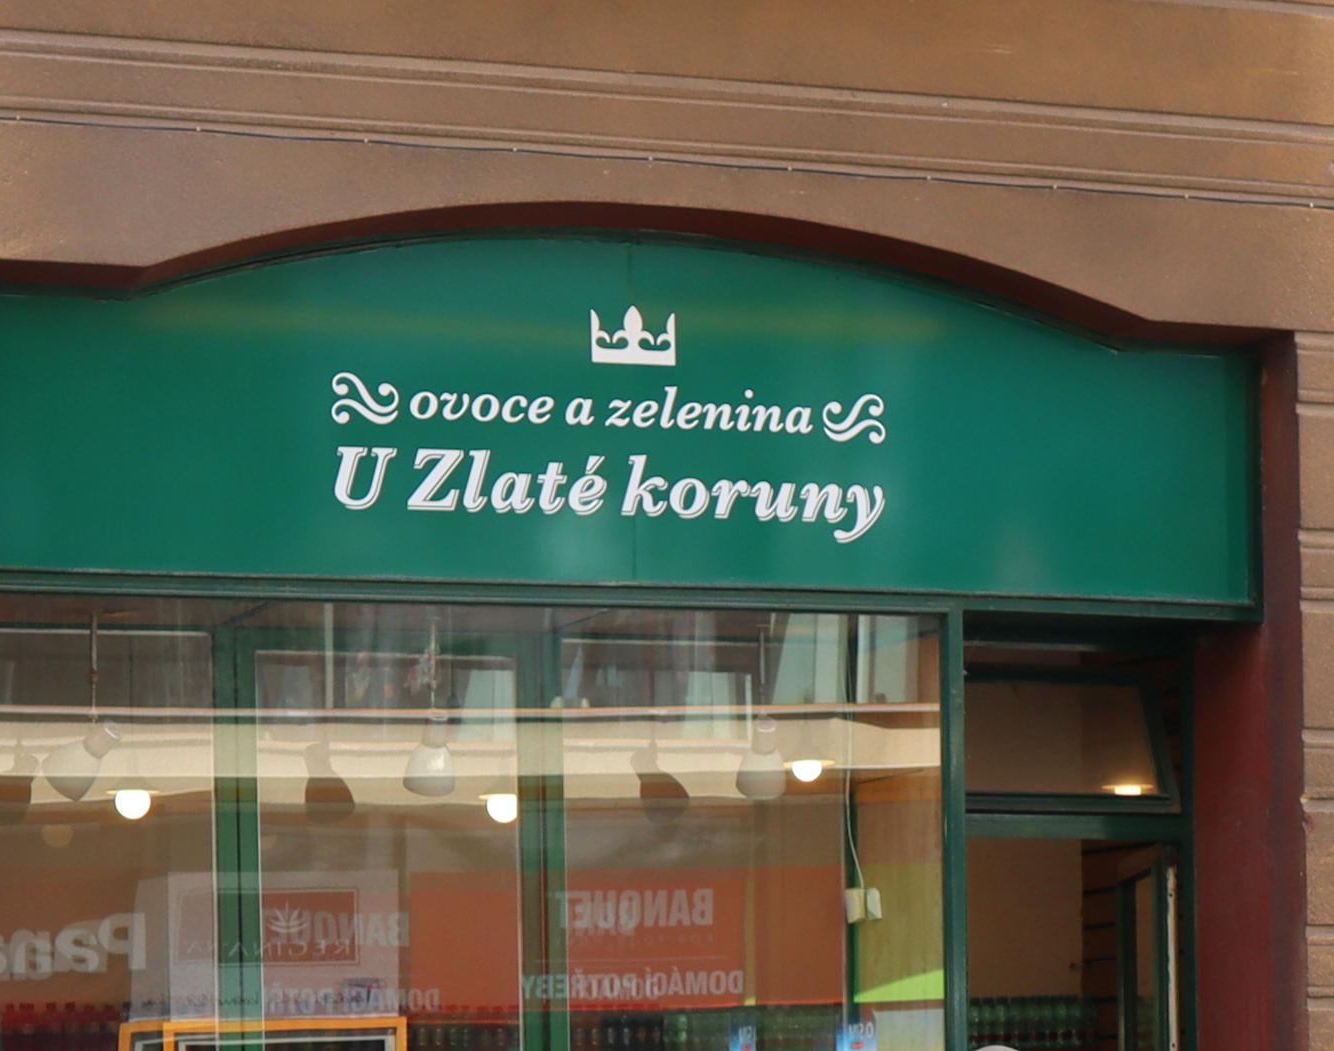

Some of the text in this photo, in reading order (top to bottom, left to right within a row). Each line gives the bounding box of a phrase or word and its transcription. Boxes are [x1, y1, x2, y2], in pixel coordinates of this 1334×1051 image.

[409, 385, 813, 433] ovoce a zelenina
[332, 445, 885, 543] U Zlaté koruny
